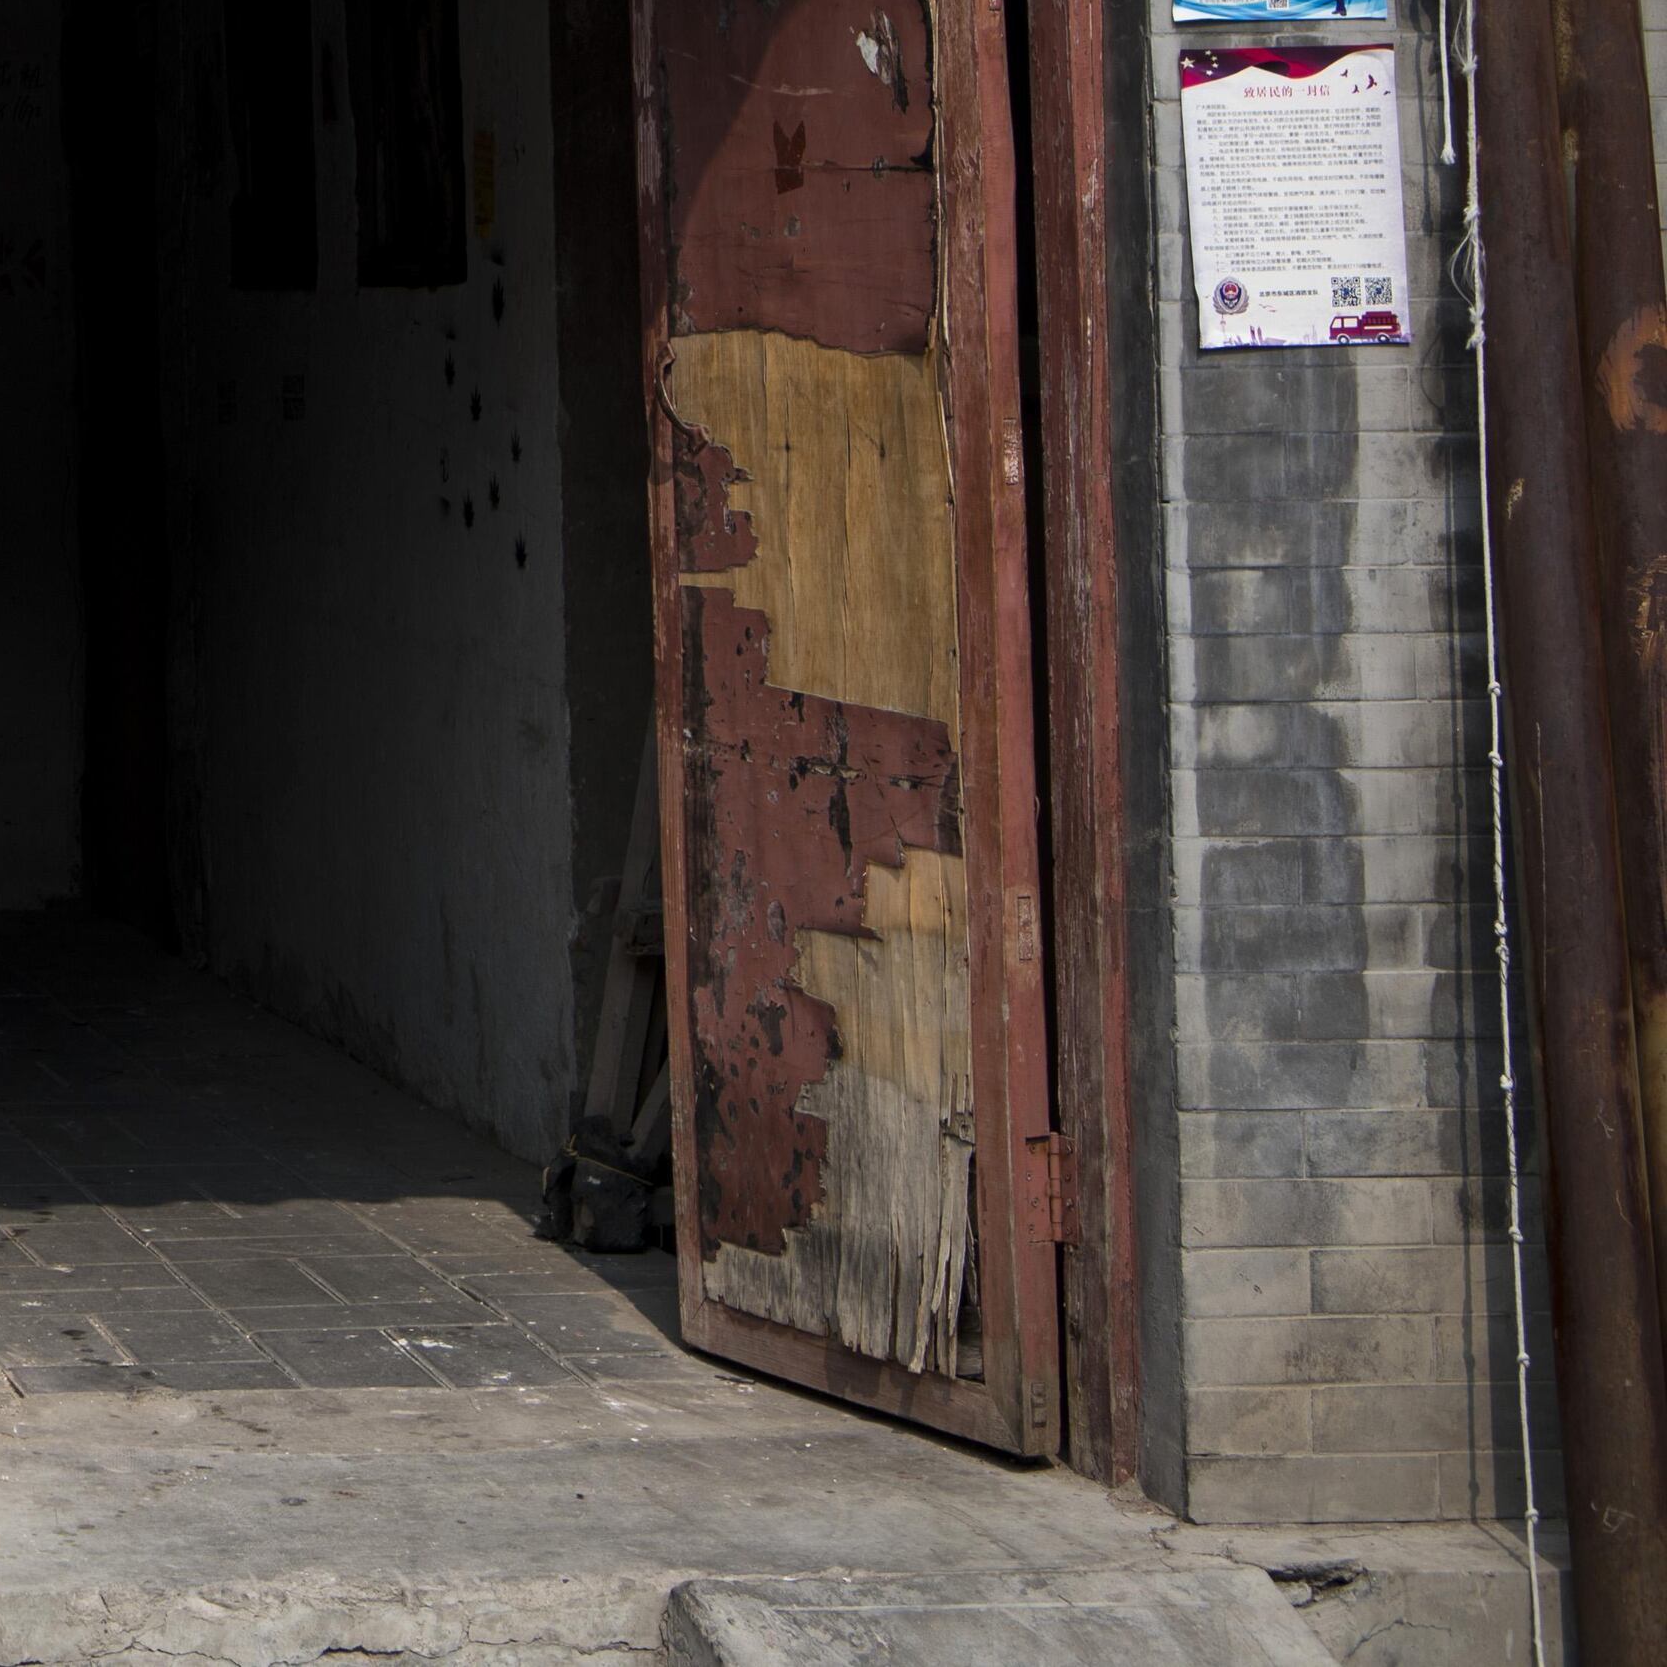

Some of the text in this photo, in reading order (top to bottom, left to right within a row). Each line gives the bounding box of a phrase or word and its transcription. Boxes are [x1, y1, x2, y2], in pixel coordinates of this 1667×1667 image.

[1243, 84, 1331, 98] 致居民的一封信
